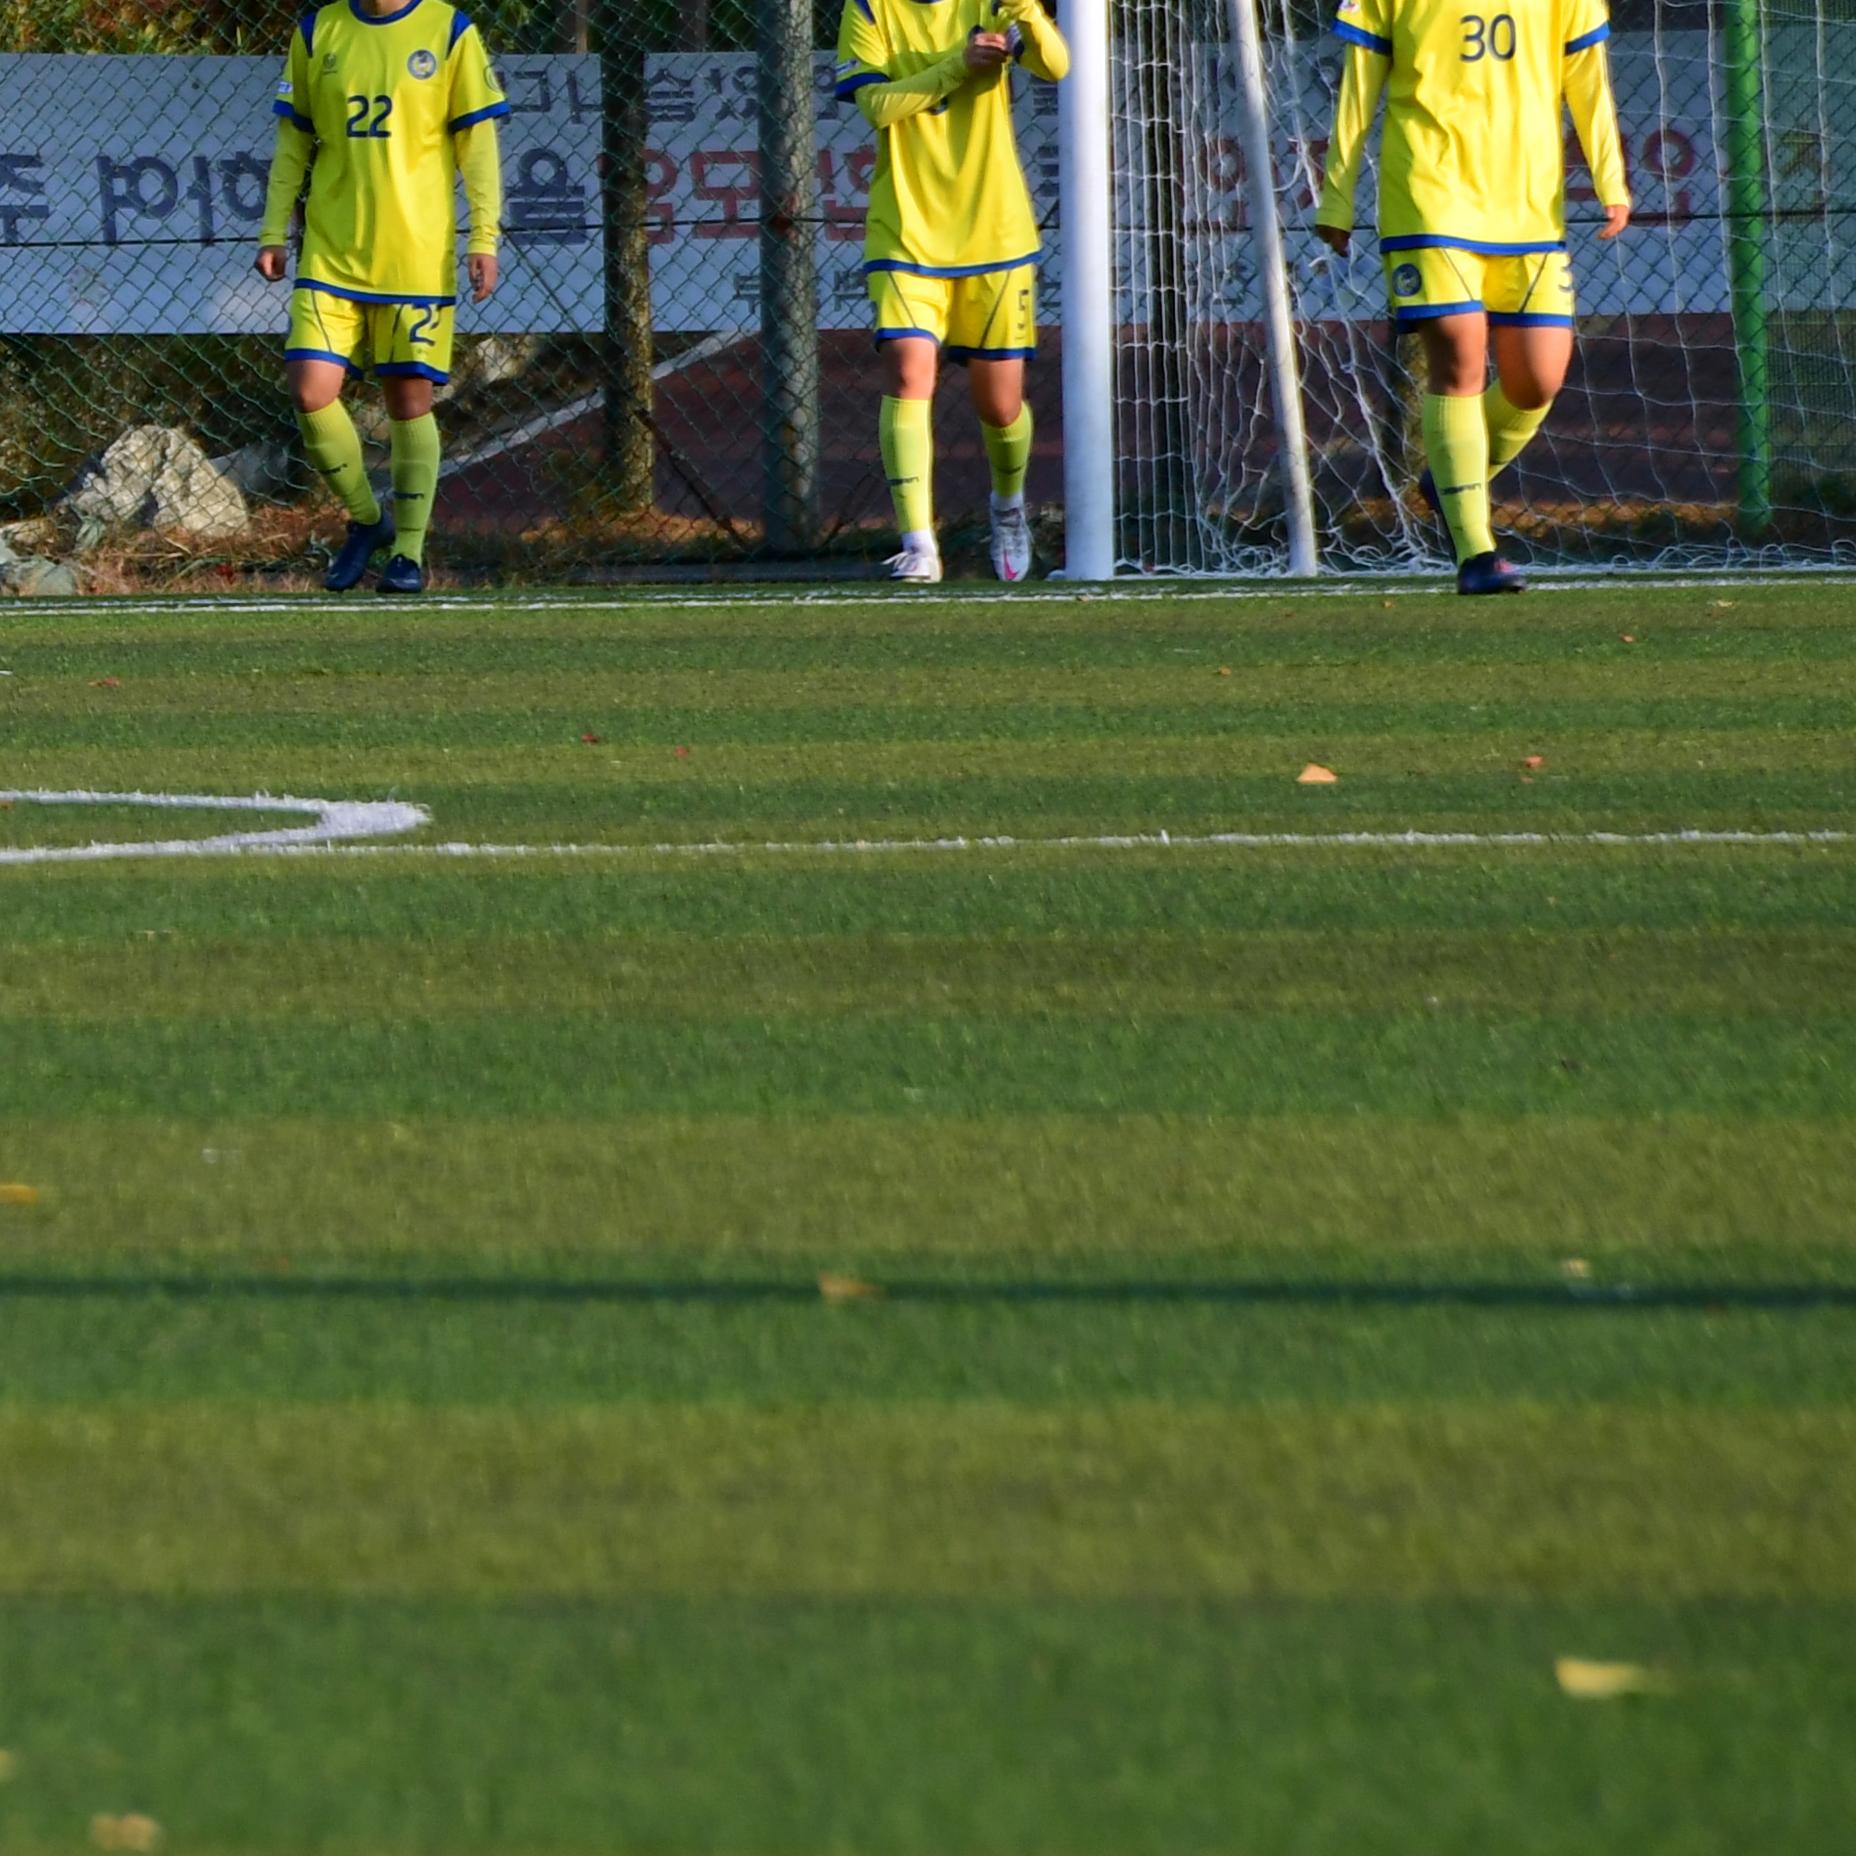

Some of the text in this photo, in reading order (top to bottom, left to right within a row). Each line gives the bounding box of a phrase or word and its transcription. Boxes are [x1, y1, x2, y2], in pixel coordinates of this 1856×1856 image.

[1460, 13, 1517, 63] 30
[346, 94, 393, 138] 22
[408, 303, 441, 347] 2
